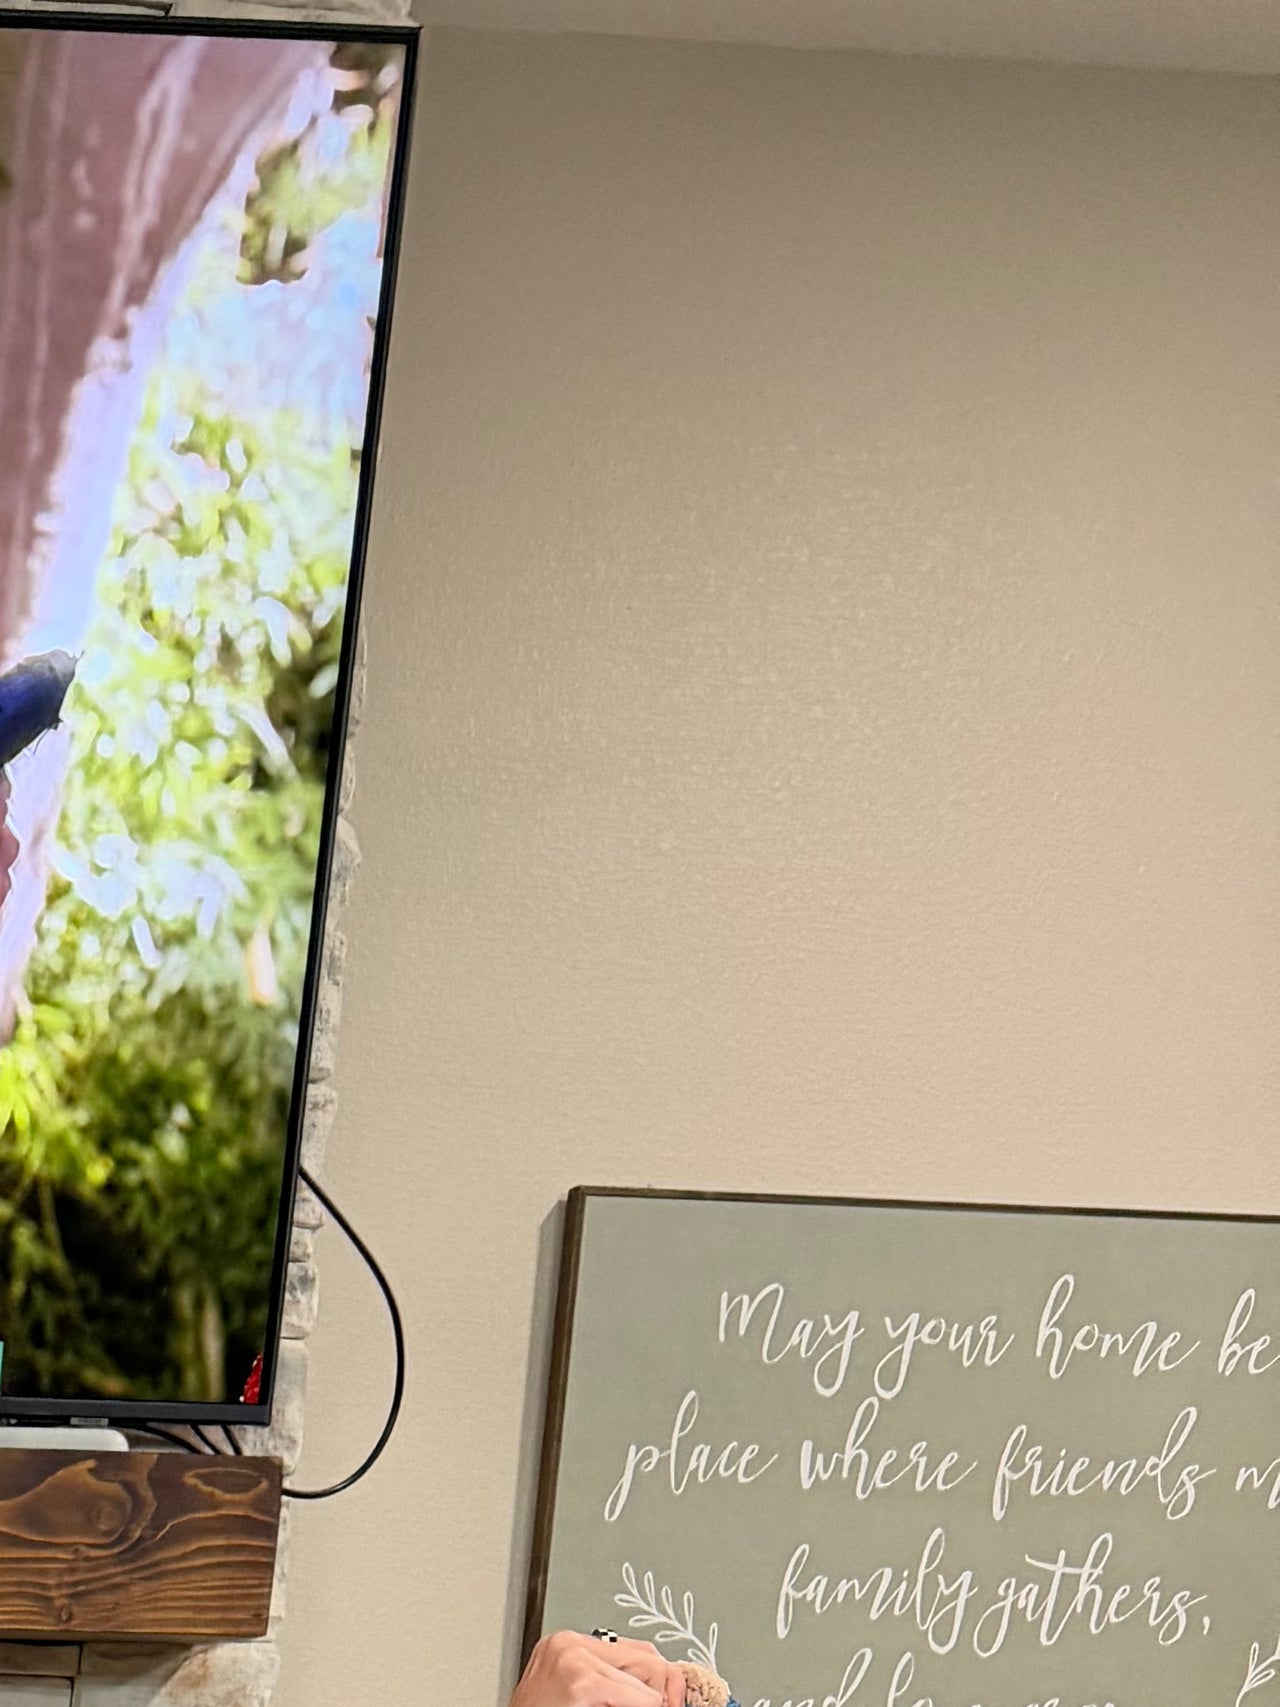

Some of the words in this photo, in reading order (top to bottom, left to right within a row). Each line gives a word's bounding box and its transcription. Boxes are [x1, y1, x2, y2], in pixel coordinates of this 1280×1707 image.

[718, 1283, 866, 1398] May
[873, 1312, 1016, 1401] your
[1036, 1273, 1201, 1380] home
[1217, 1287, 1280, 1377] be
[603, 1389, 779, 1522] place
[799, 1395, 978, 1501] where
[992, 1406, 1218, 1522] friends
[776, 1526, 979, 1656] family
[972, 1532, 1212, 1659] gathers,
